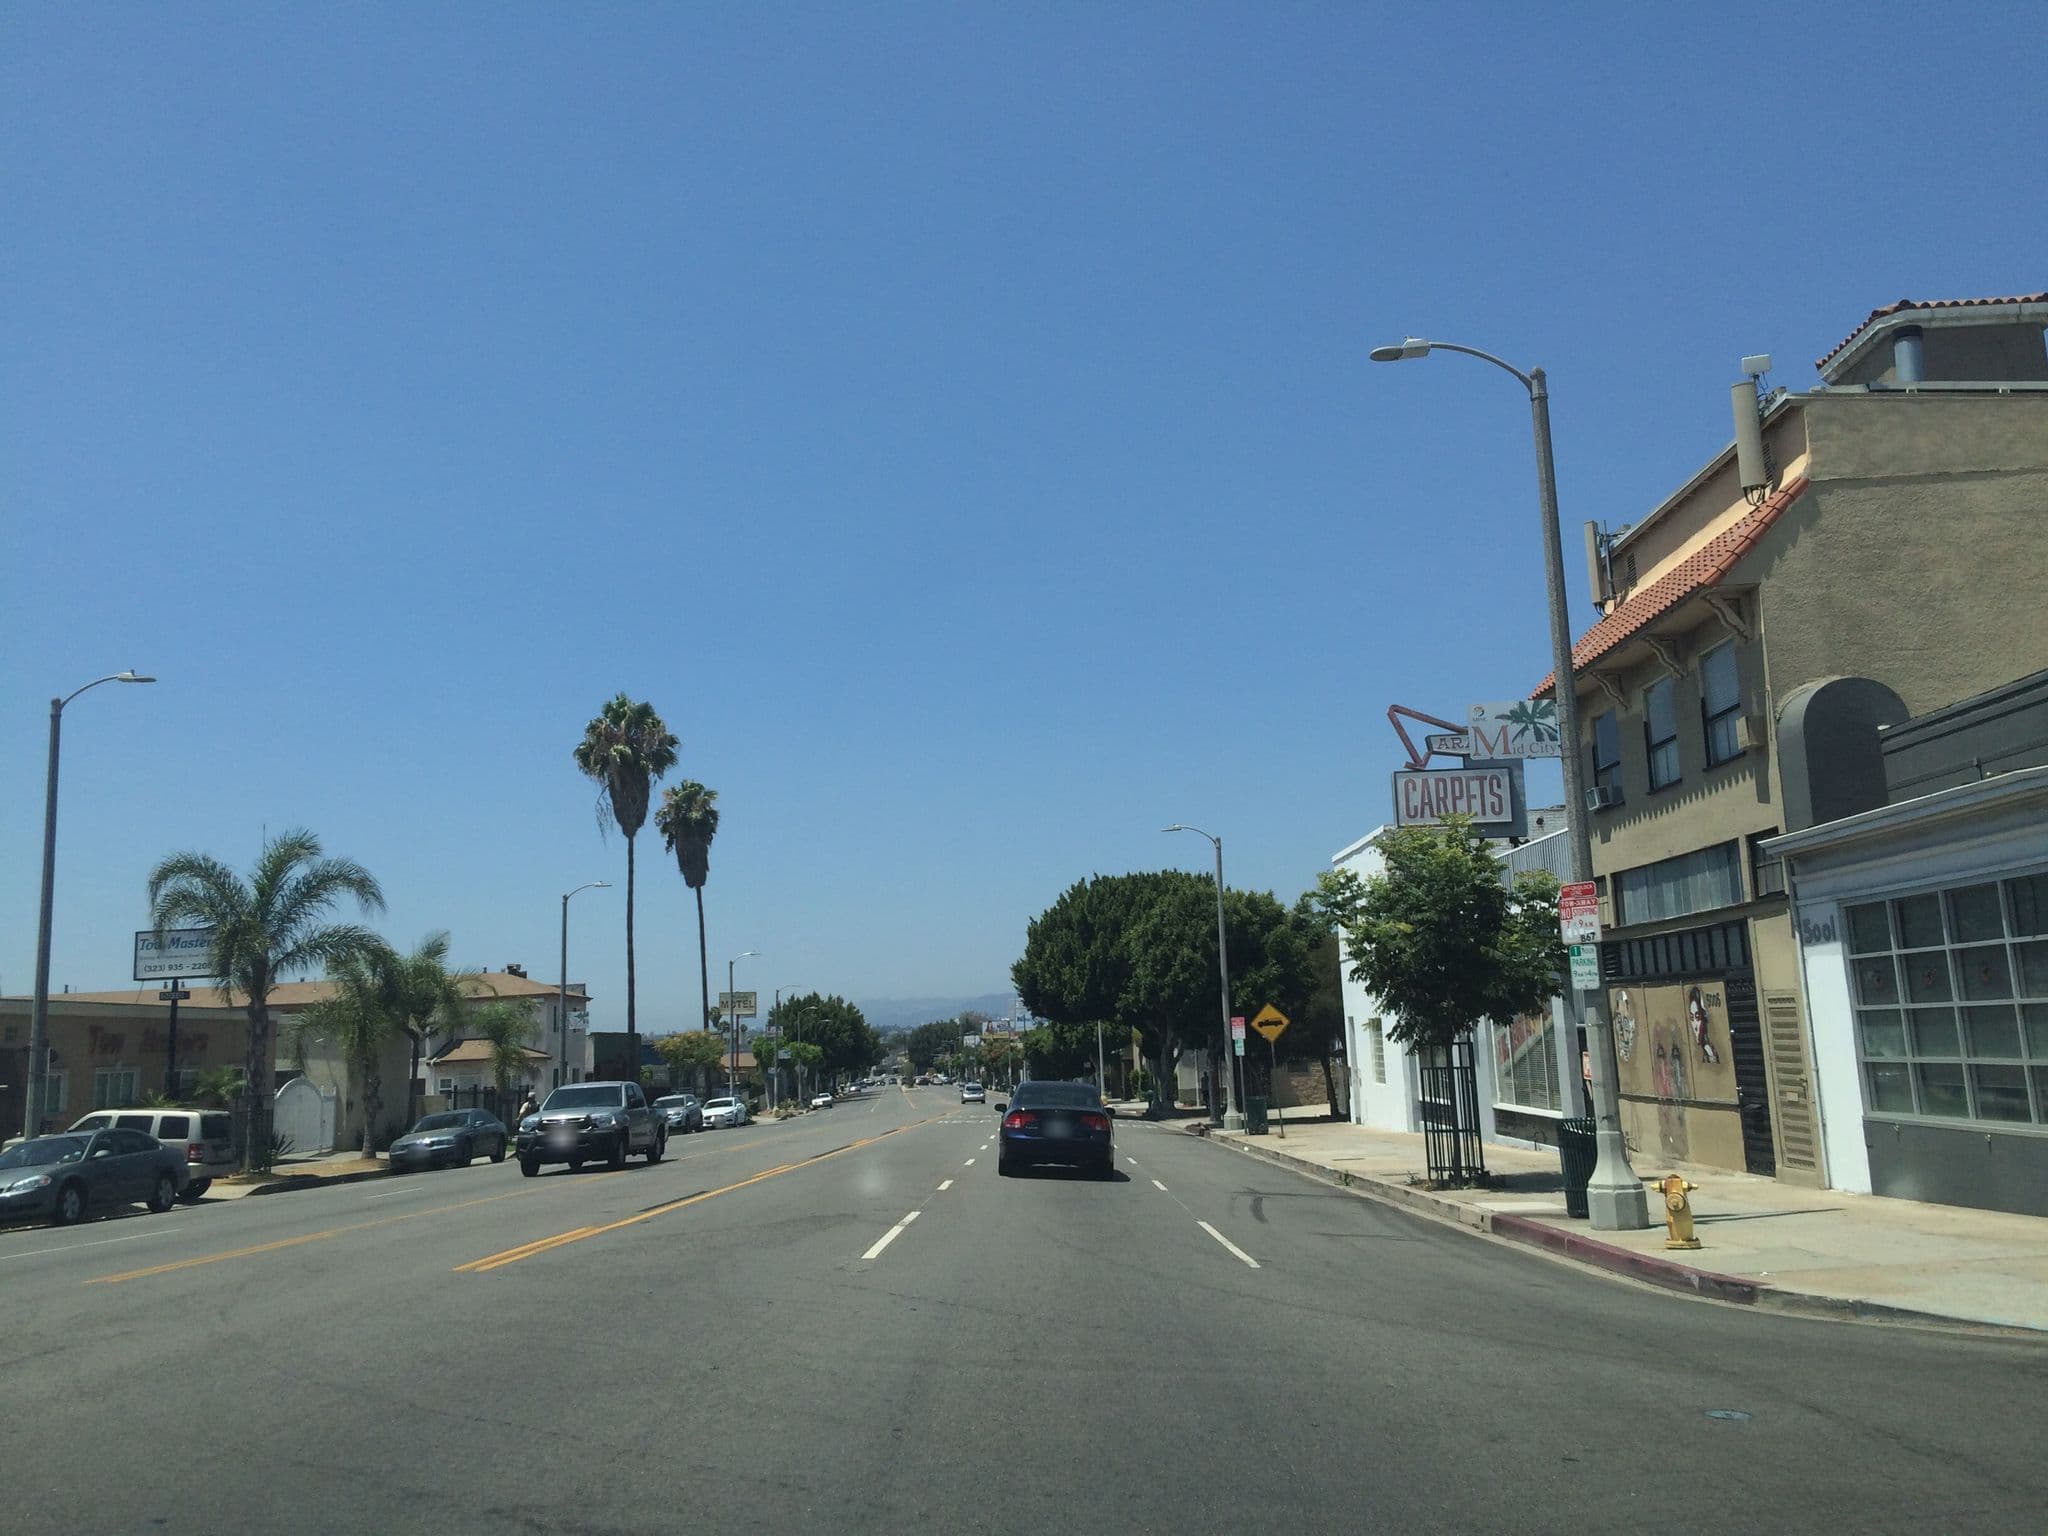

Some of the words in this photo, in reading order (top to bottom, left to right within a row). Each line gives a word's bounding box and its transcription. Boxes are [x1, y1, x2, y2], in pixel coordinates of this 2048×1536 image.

[1472, 724, 1524, 757] Mid
[1529, 741, 1557, 755] City
[1403, 774, 1504, 820] CARPETS
[1560, 899, 1596, 907] TOW-AWAY
[1560, 907, 1571, 920] NO
[1573, 907, 1597, 916] STOPPING
[167, 963, 184, 971] 935
[1572, 957, 1597, 967] PARKING
[720, 999, 755, 1009] MOTEL
